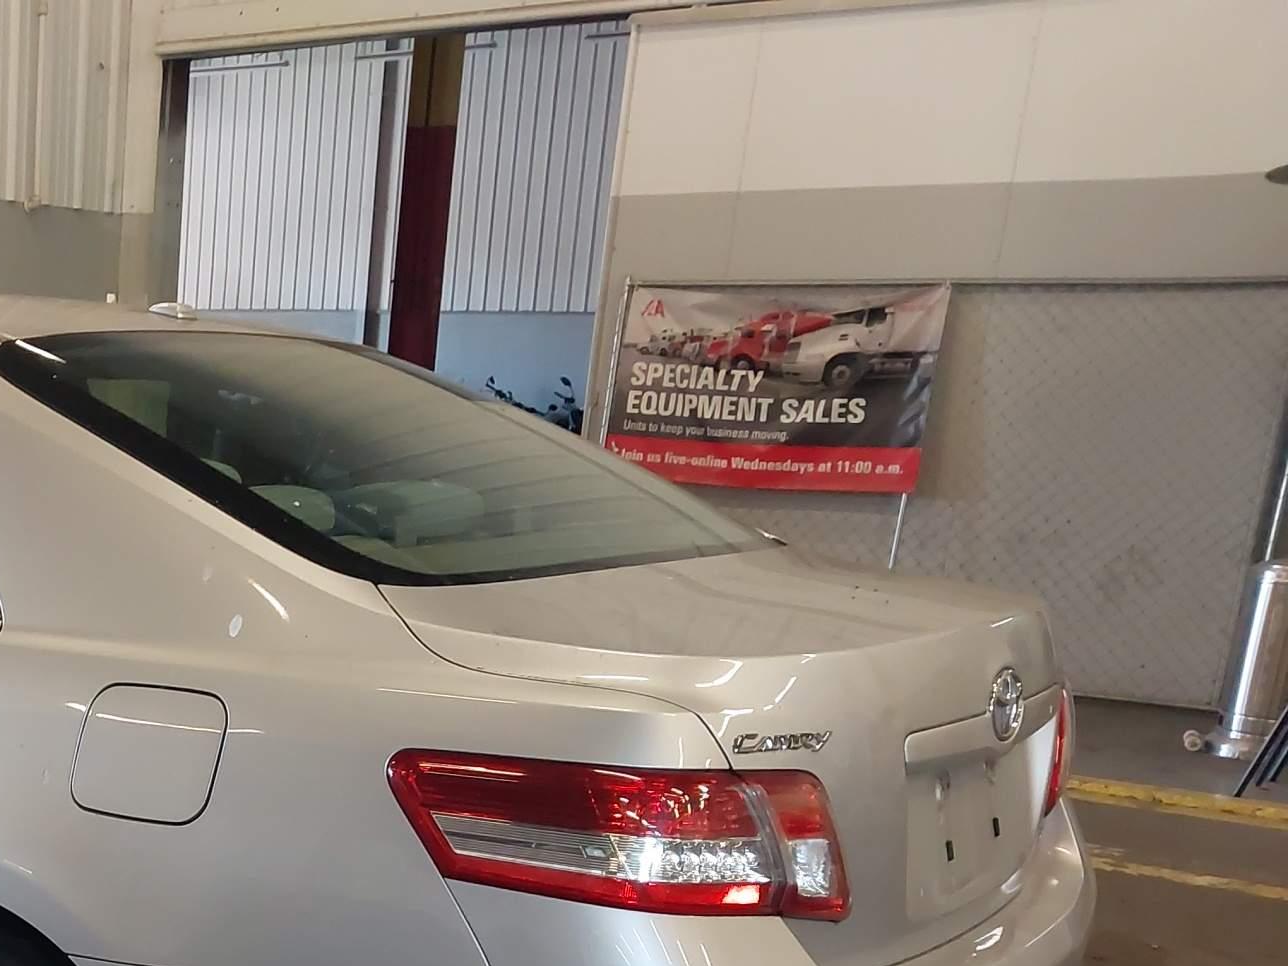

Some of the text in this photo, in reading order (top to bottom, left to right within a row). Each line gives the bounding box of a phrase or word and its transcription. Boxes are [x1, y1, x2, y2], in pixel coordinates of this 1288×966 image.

[631, 362, 764, 392] SPECIALTY
[626, 391, 866, 424] EQUIPMENT SALES
[623, 419, 790, 442] Units to keep your business moving.
[647, 452, 661, 463] us
[664, 452, 728, 468] live-online
[731, 456, 814, 474] Wednesdays
[817, 461, 832, 473] at
[836, 460, 872, 474] 11:00
[874, 464, 904, 475] a.m.
